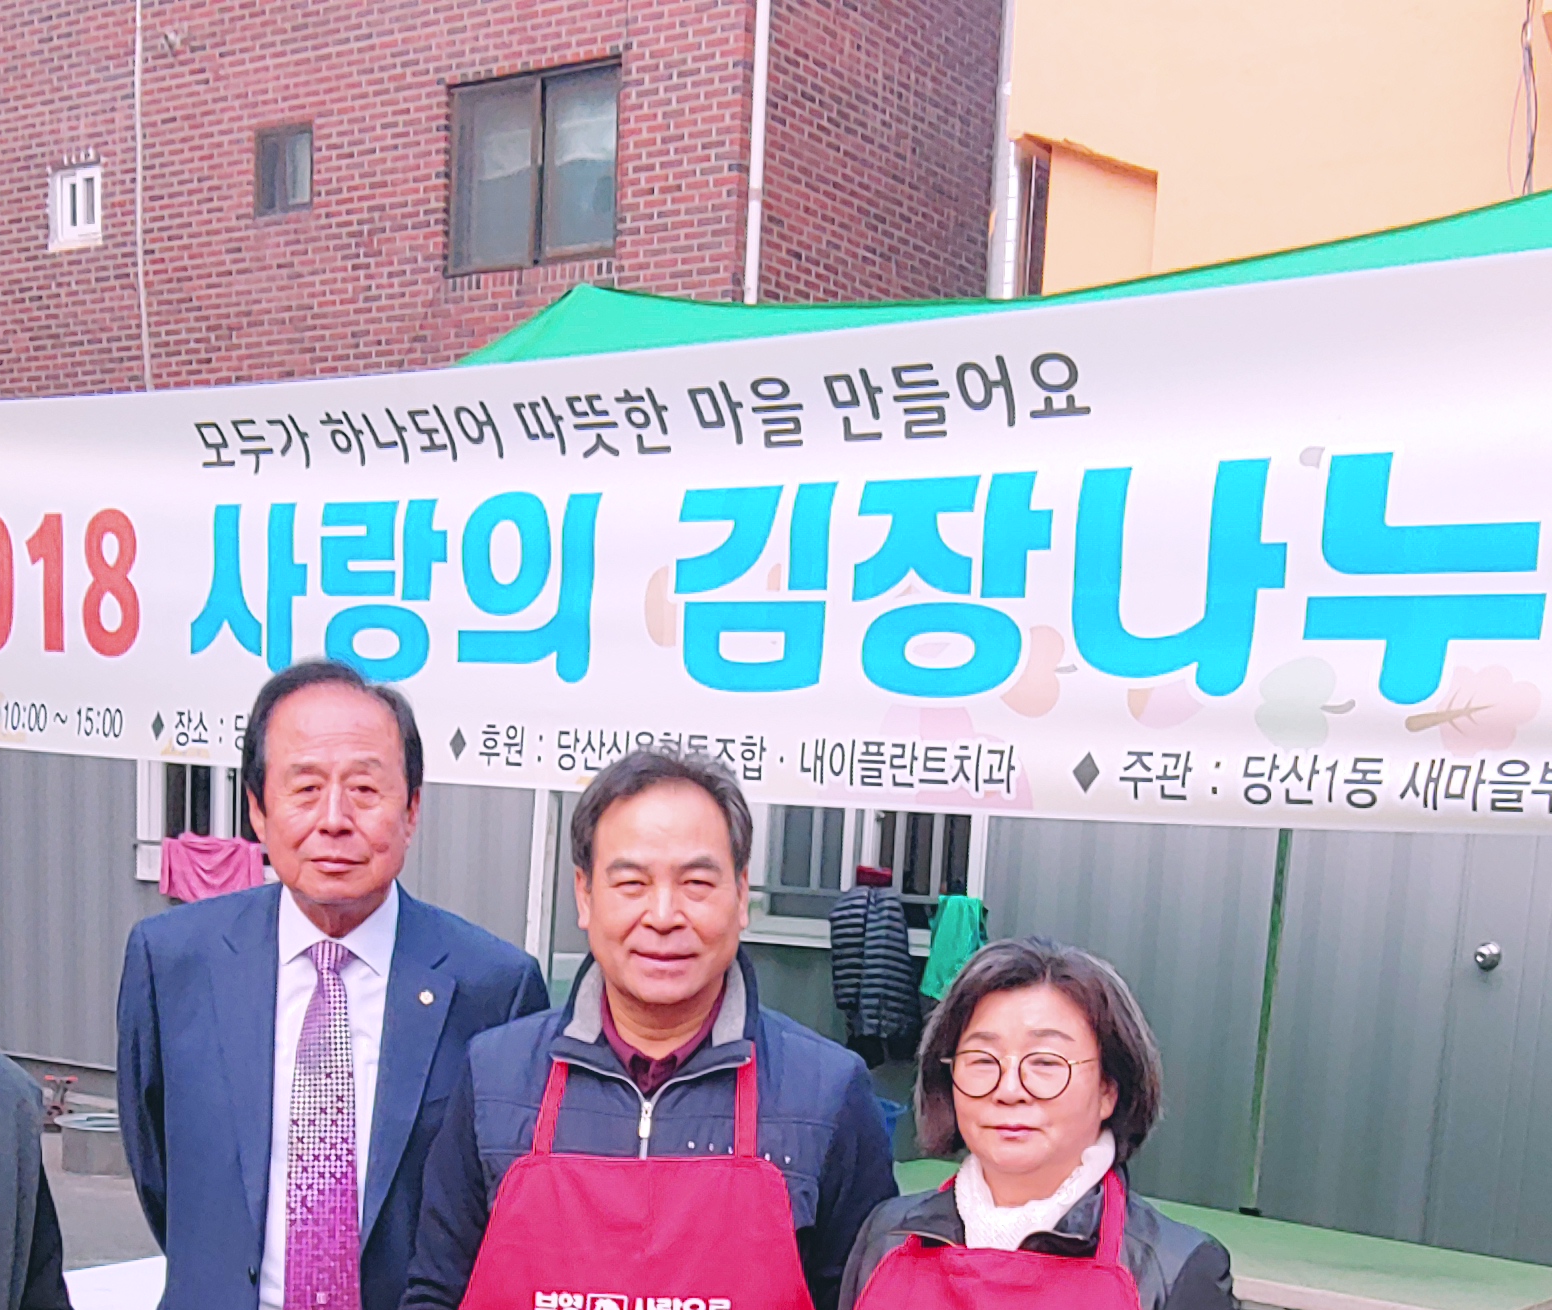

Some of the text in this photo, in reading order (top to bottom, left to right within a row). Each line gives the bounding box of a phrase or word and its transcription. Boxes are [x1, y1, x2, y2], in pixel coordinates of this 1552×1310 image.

[194, 352, 1092, 474] 모두가 하나되어 따뜻한 마을 만들어요
[190, 491, 603, 685] 사랑의
[4, 700, 47, 732] 10:00
[76, 706, 123, 738] 15:00
[174, 708, 209, 747] 장소
[478, 723, 525, 767] 후원
[799, 741, 1017, 795] 내이플란트치과
[1118, 749, 1193, 801] 주관
[1241, 753, 1384, 809] 당산1동
